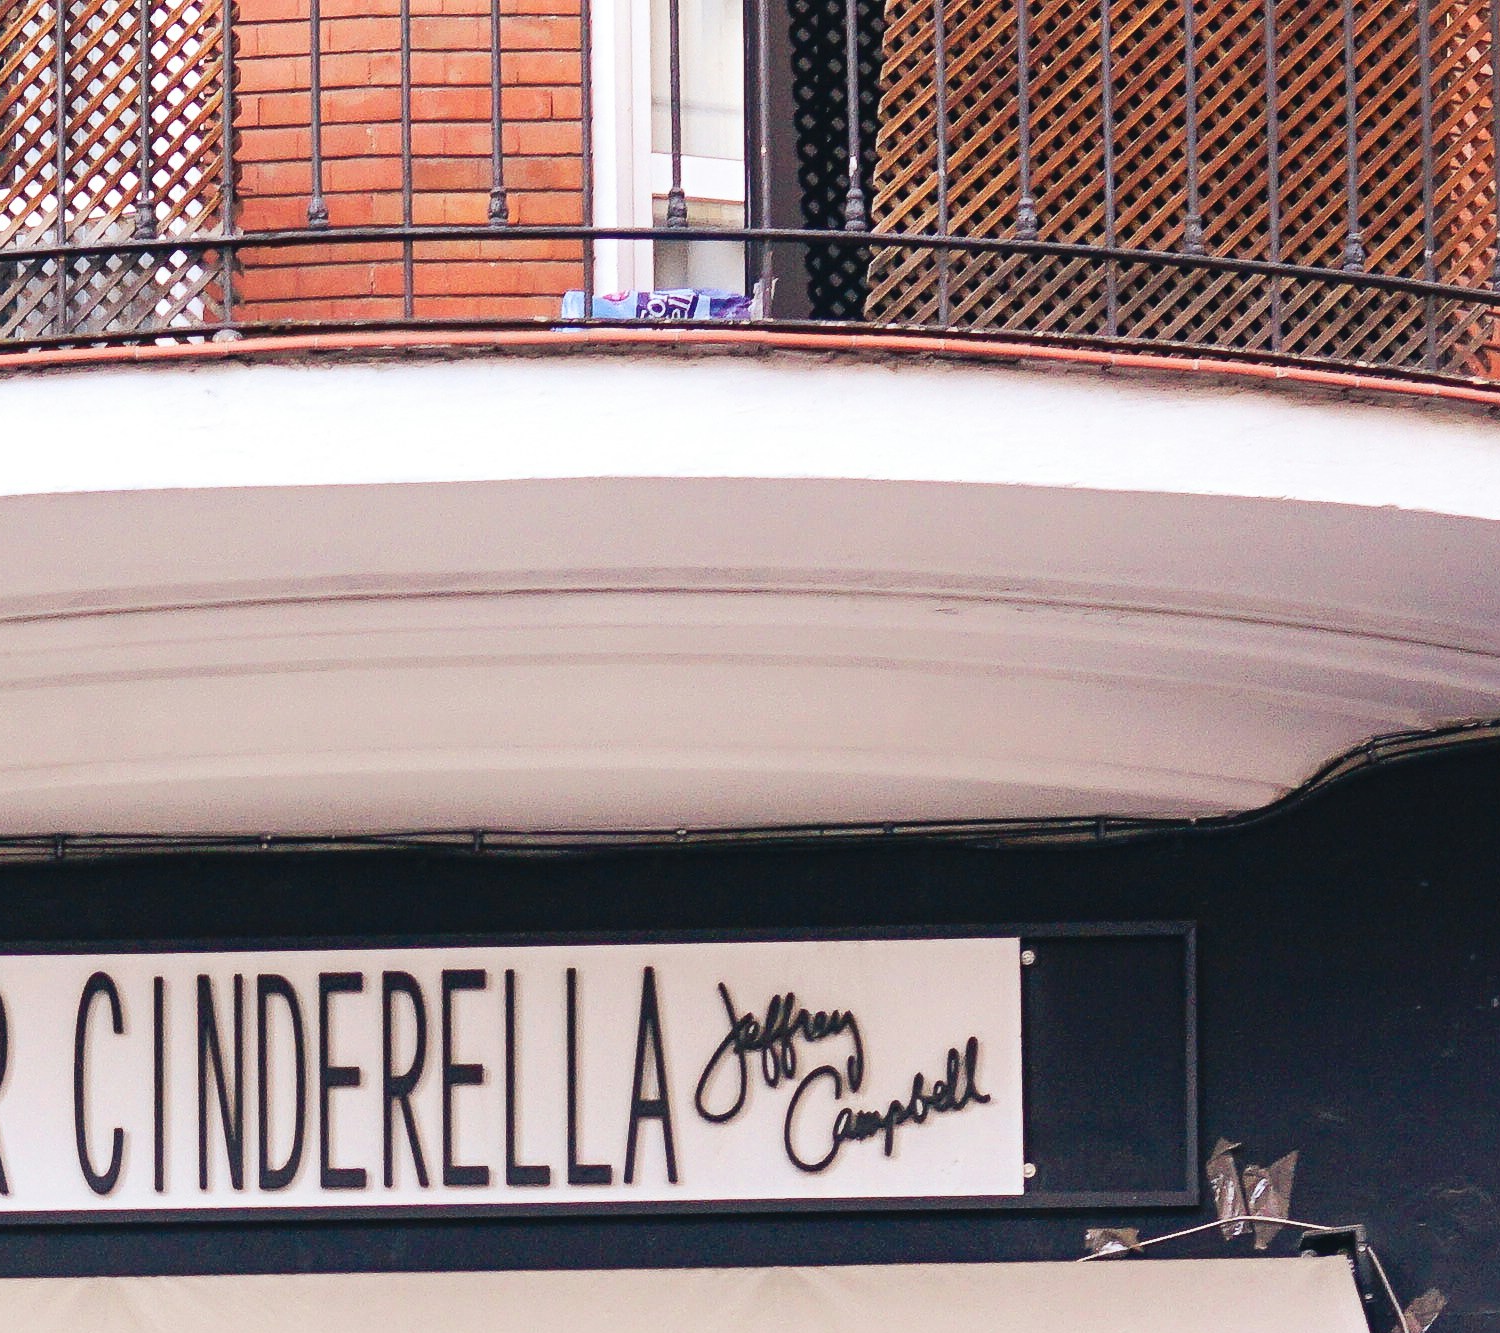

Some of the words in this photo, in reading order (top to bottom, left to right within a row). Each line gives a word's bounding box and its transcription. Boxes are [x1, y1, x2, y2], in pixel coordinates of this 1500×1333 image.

[73, 966, 678, 1197] CINDERELLA
[696, 982, 864, 1123] Jeffrey
[785, 1036, 990, 1172] Campbell
